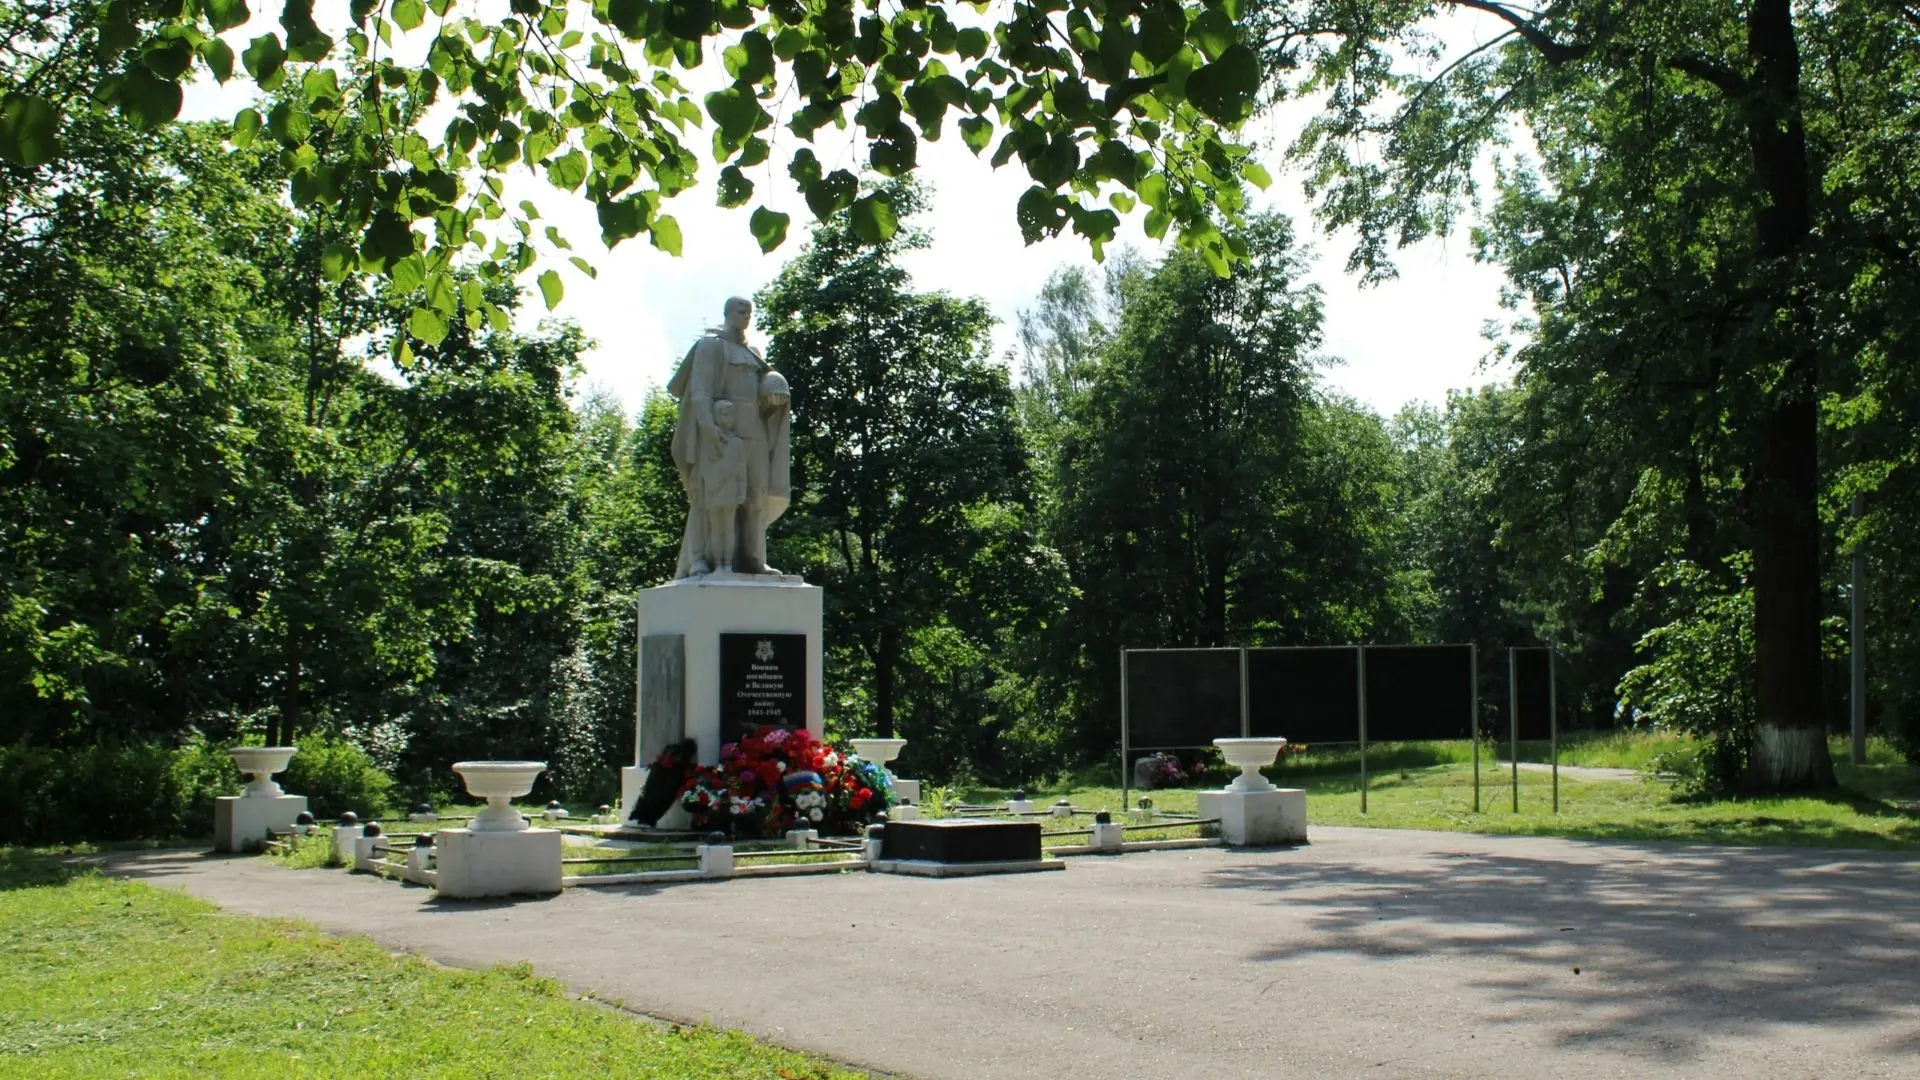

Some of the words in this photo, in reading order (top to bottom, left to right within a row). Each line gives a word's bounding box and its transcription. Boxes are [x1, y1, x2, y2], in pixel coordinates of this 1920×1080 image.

[752, 682, 784, 690] Великую
[736, 691, 793, 699] Отечественную
[748, 708, 782, 716] 1941-1945
